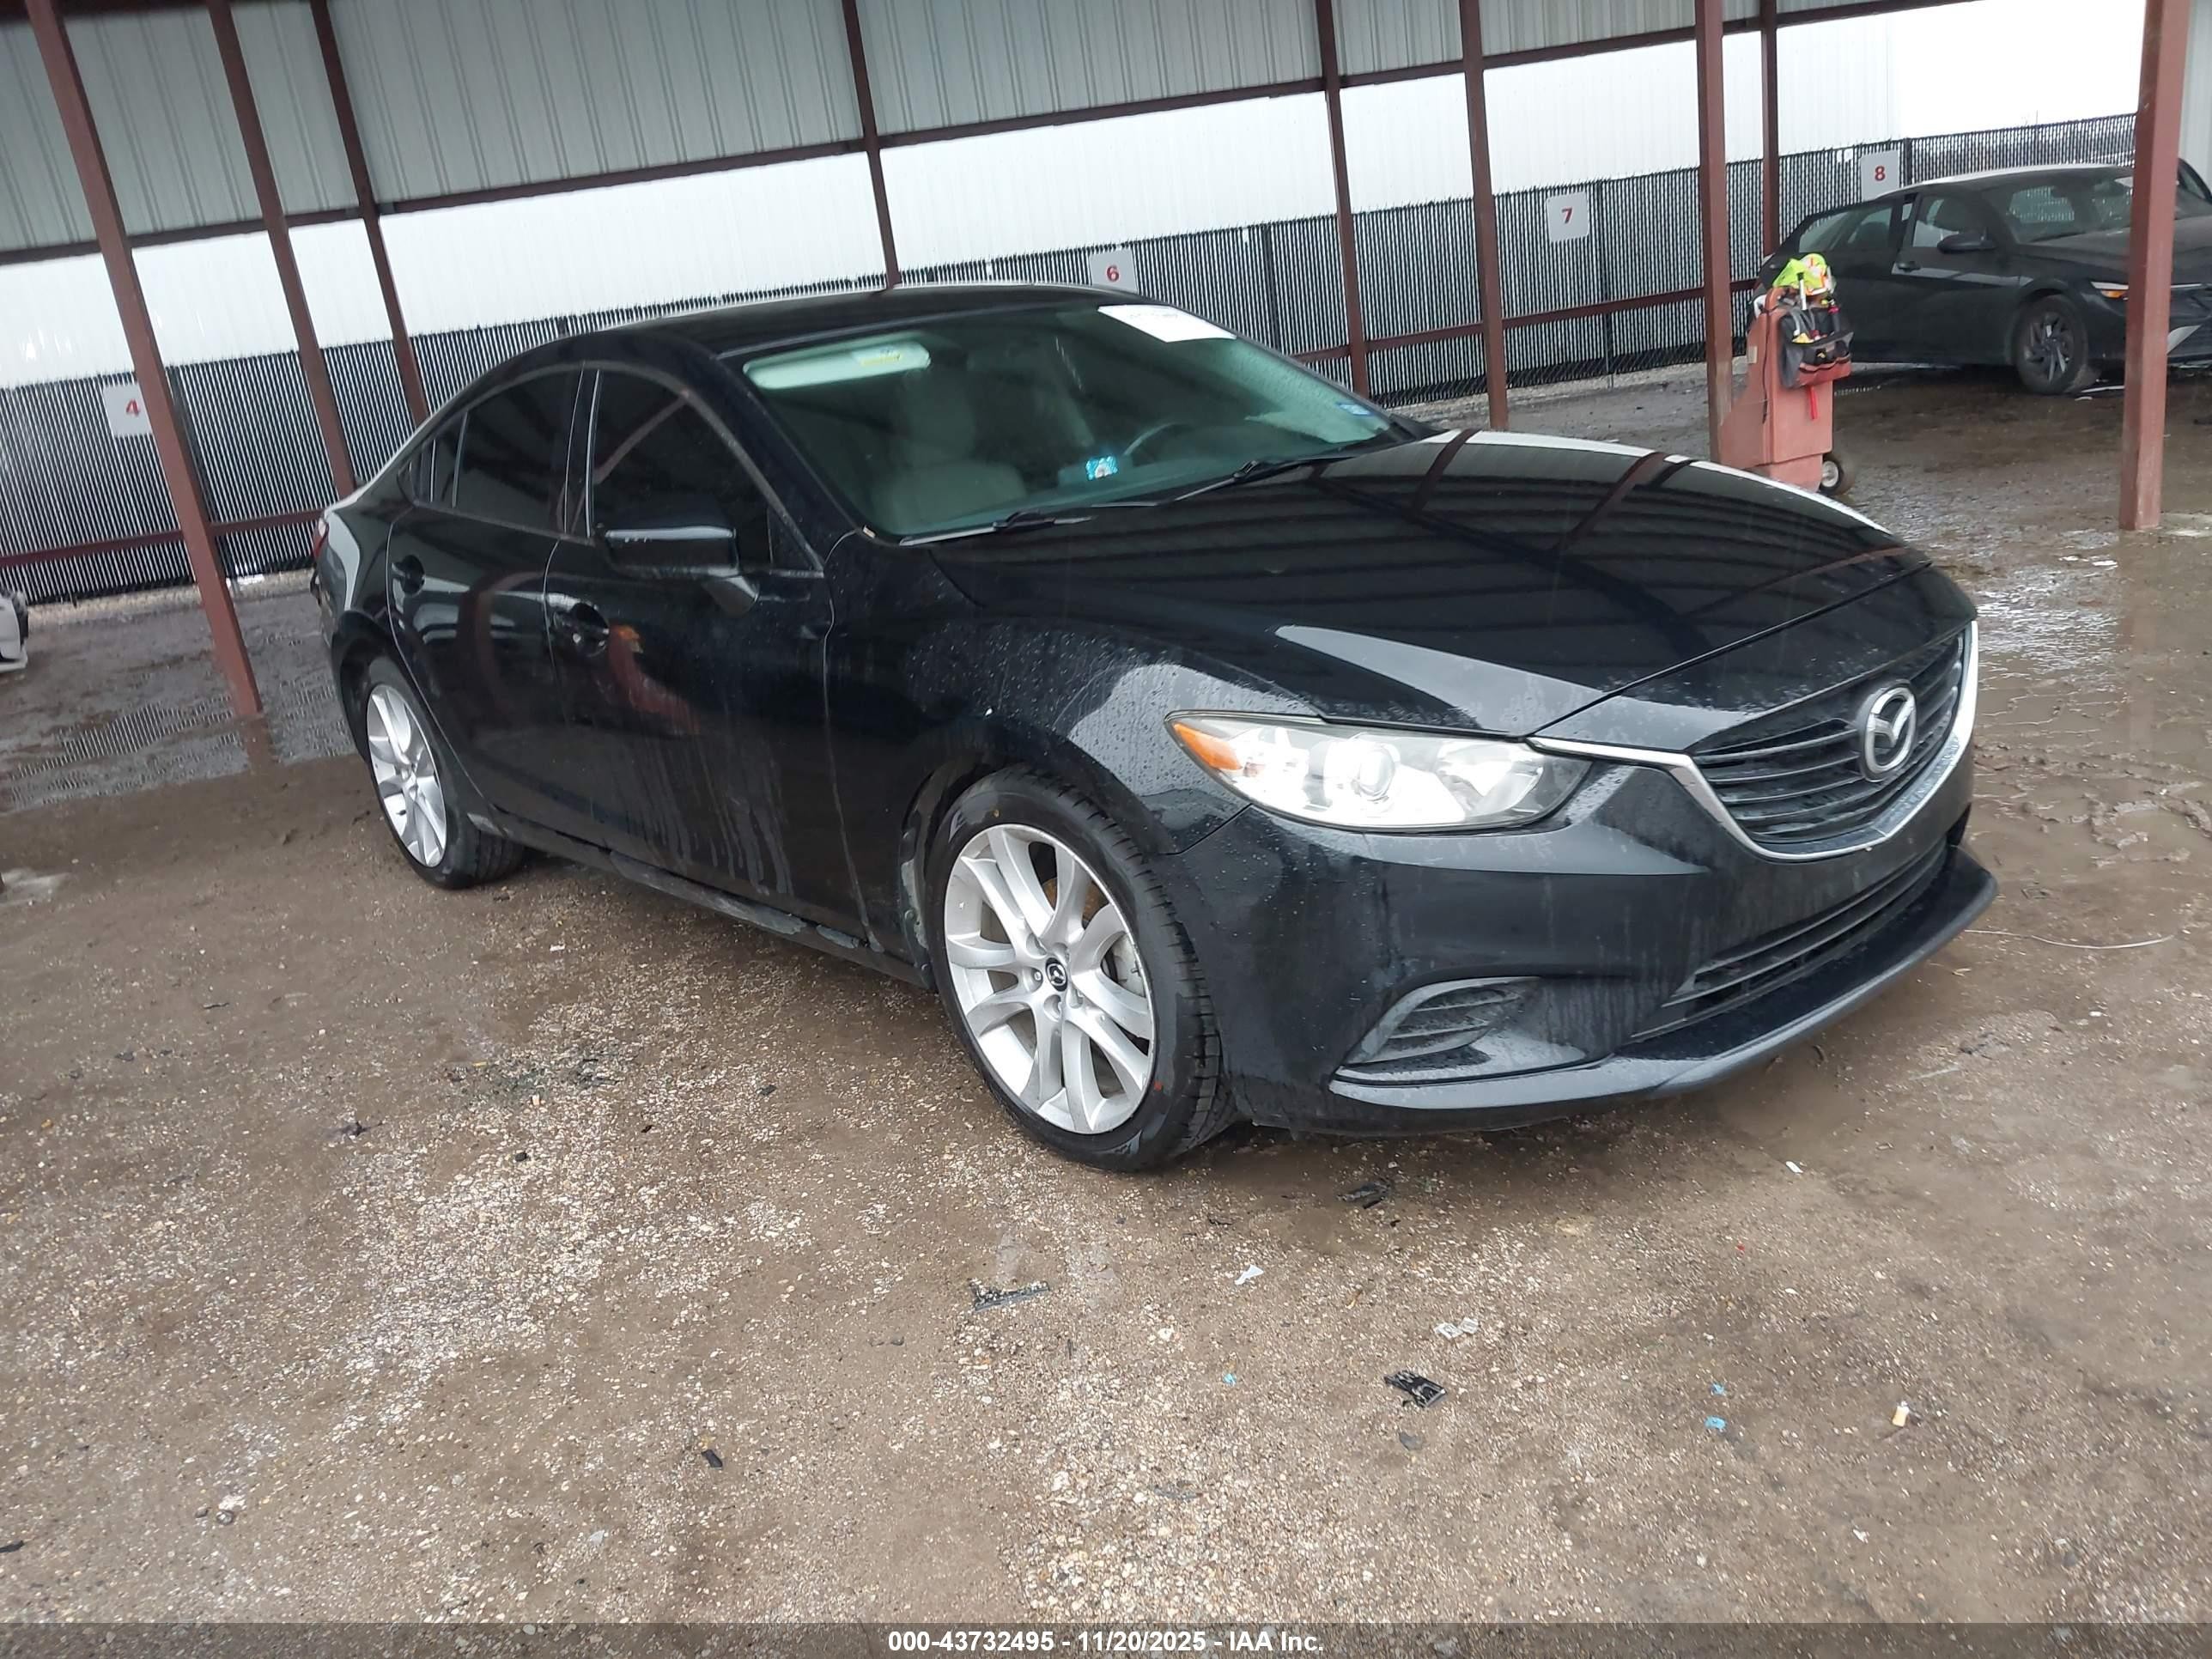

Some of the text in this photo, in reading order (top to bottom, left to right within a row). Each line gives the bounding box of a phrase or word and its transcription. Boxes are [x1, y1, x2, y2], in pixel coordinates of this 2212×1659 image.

[1875, 165, 1886, 181] 8
[1561, 207, 1573, 224] 7
[1106, 264, 1120, 282] 6
[125, 398, 141, 416] 4
